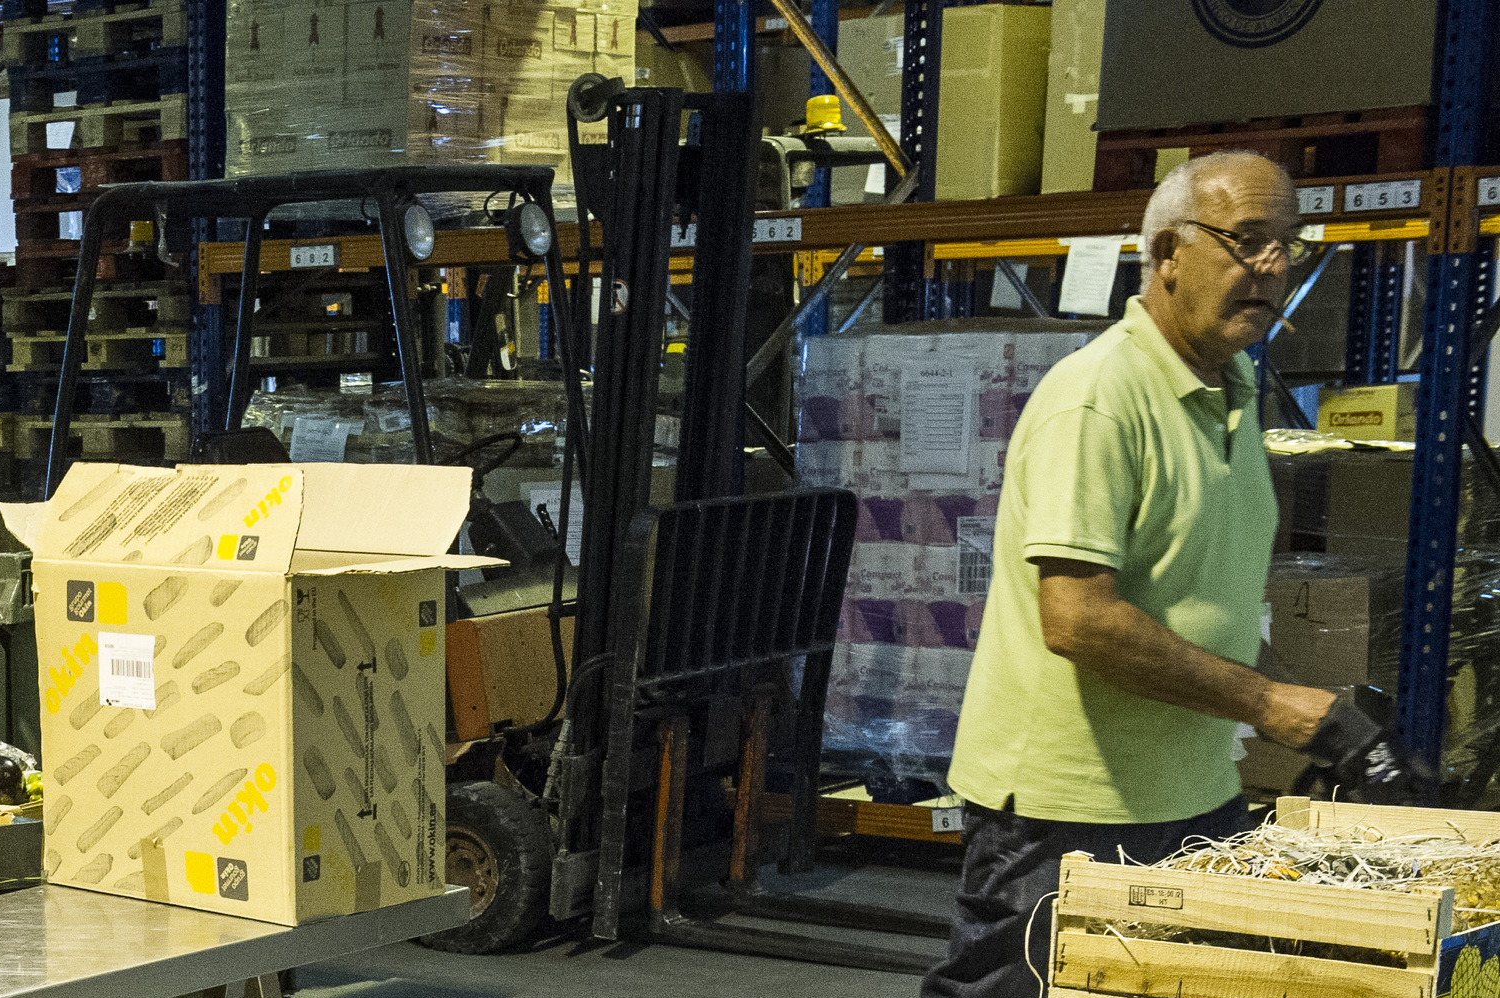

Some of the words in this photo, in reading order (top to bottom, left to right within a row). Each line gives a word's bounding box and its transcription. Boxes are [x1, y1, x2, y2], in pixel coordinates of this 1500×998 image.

[516, 133, 558, 147] Orlando
[1333, 412, 1382, 425] Orlando
[243, 475, 293, 528] okin
[45, 633, 99, 715] okin
[212, 762, 277, 845] okin
[427, 802, 437, 884] www.okin.es
